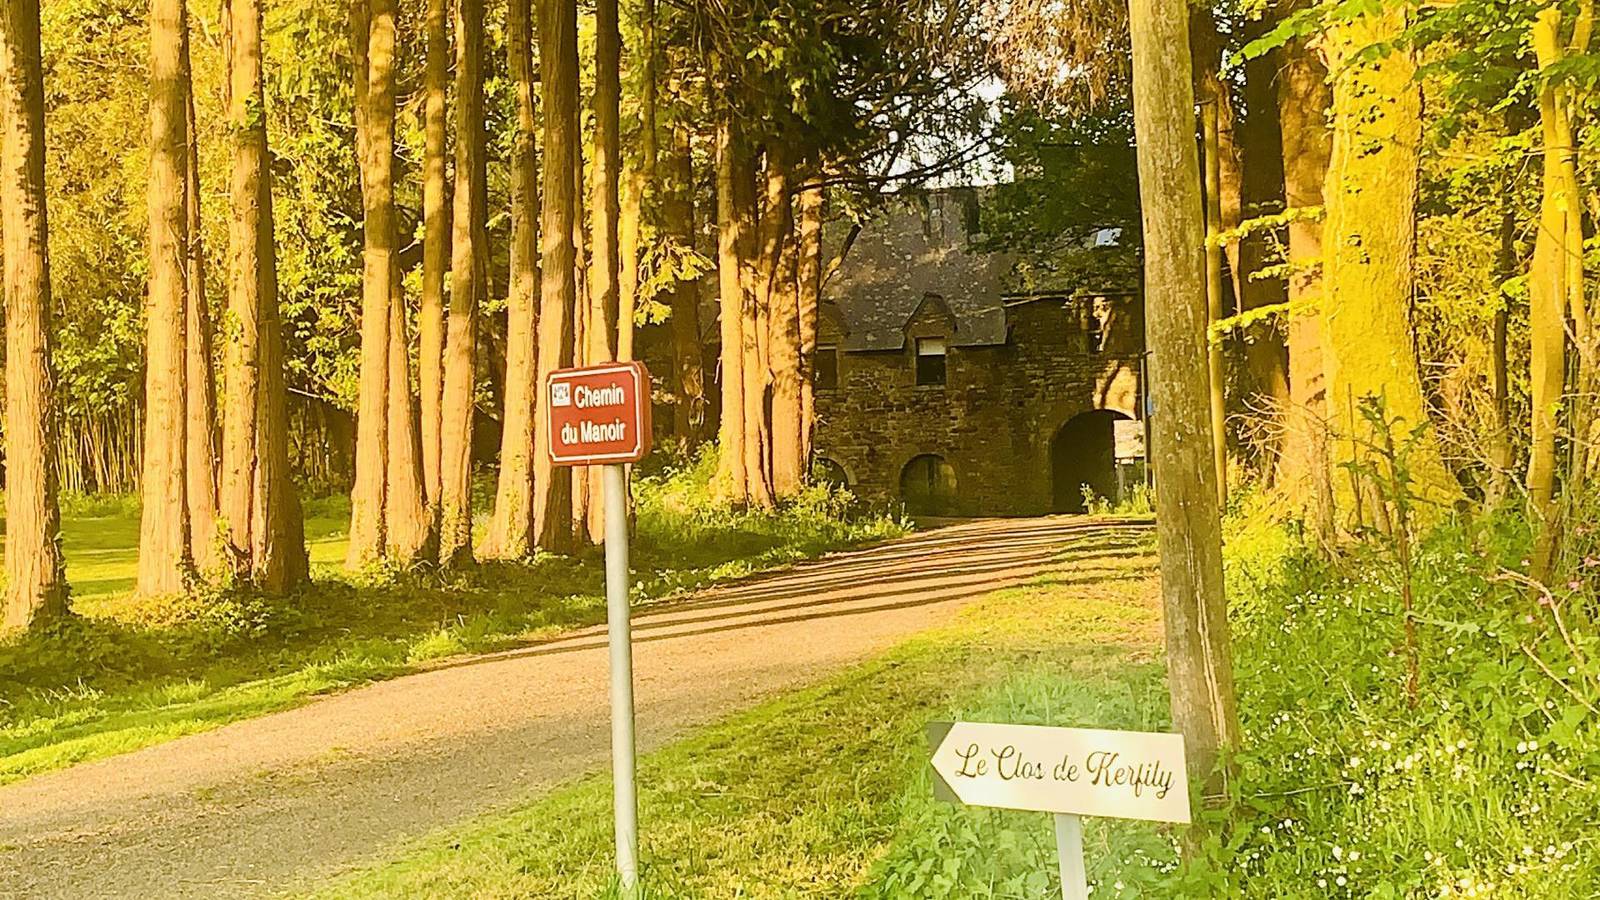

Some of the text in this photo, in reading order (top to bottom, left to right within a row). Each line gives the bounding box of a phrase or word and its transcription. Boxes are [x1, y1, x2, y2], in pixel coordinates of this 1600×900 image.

[574, 383, 625, 409] Chemin
[561, 418, 626, 445] du Manoir
[954, 743, 1175, 800] Le Clos de Kerfily
